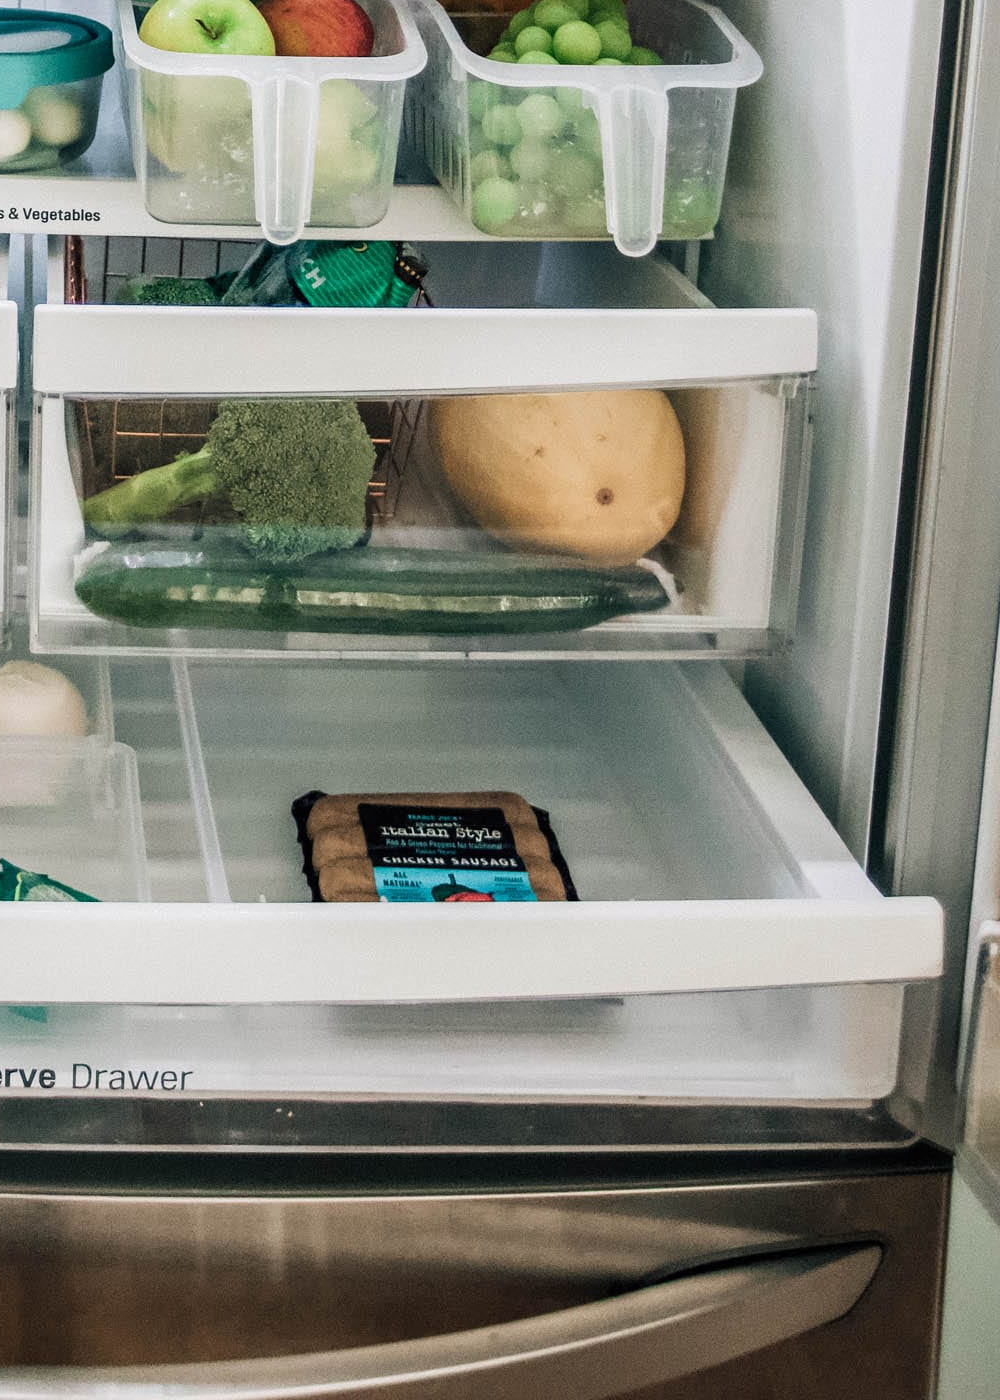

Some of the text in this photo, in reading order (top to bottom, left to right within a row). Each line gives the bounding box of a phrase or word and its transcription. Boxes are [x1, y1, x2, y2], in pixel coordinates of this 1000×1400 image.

[8, 208, 19, 220] &
[22, 207, 101, 223] Vegetables
[380, 826, 502, 842] Italian Style
[382, 856, 519, 867] CHICKEN SAUSAGE
[393, 871, 408, 879] ALL
[72, 1063, 194, 1091] Drawer
